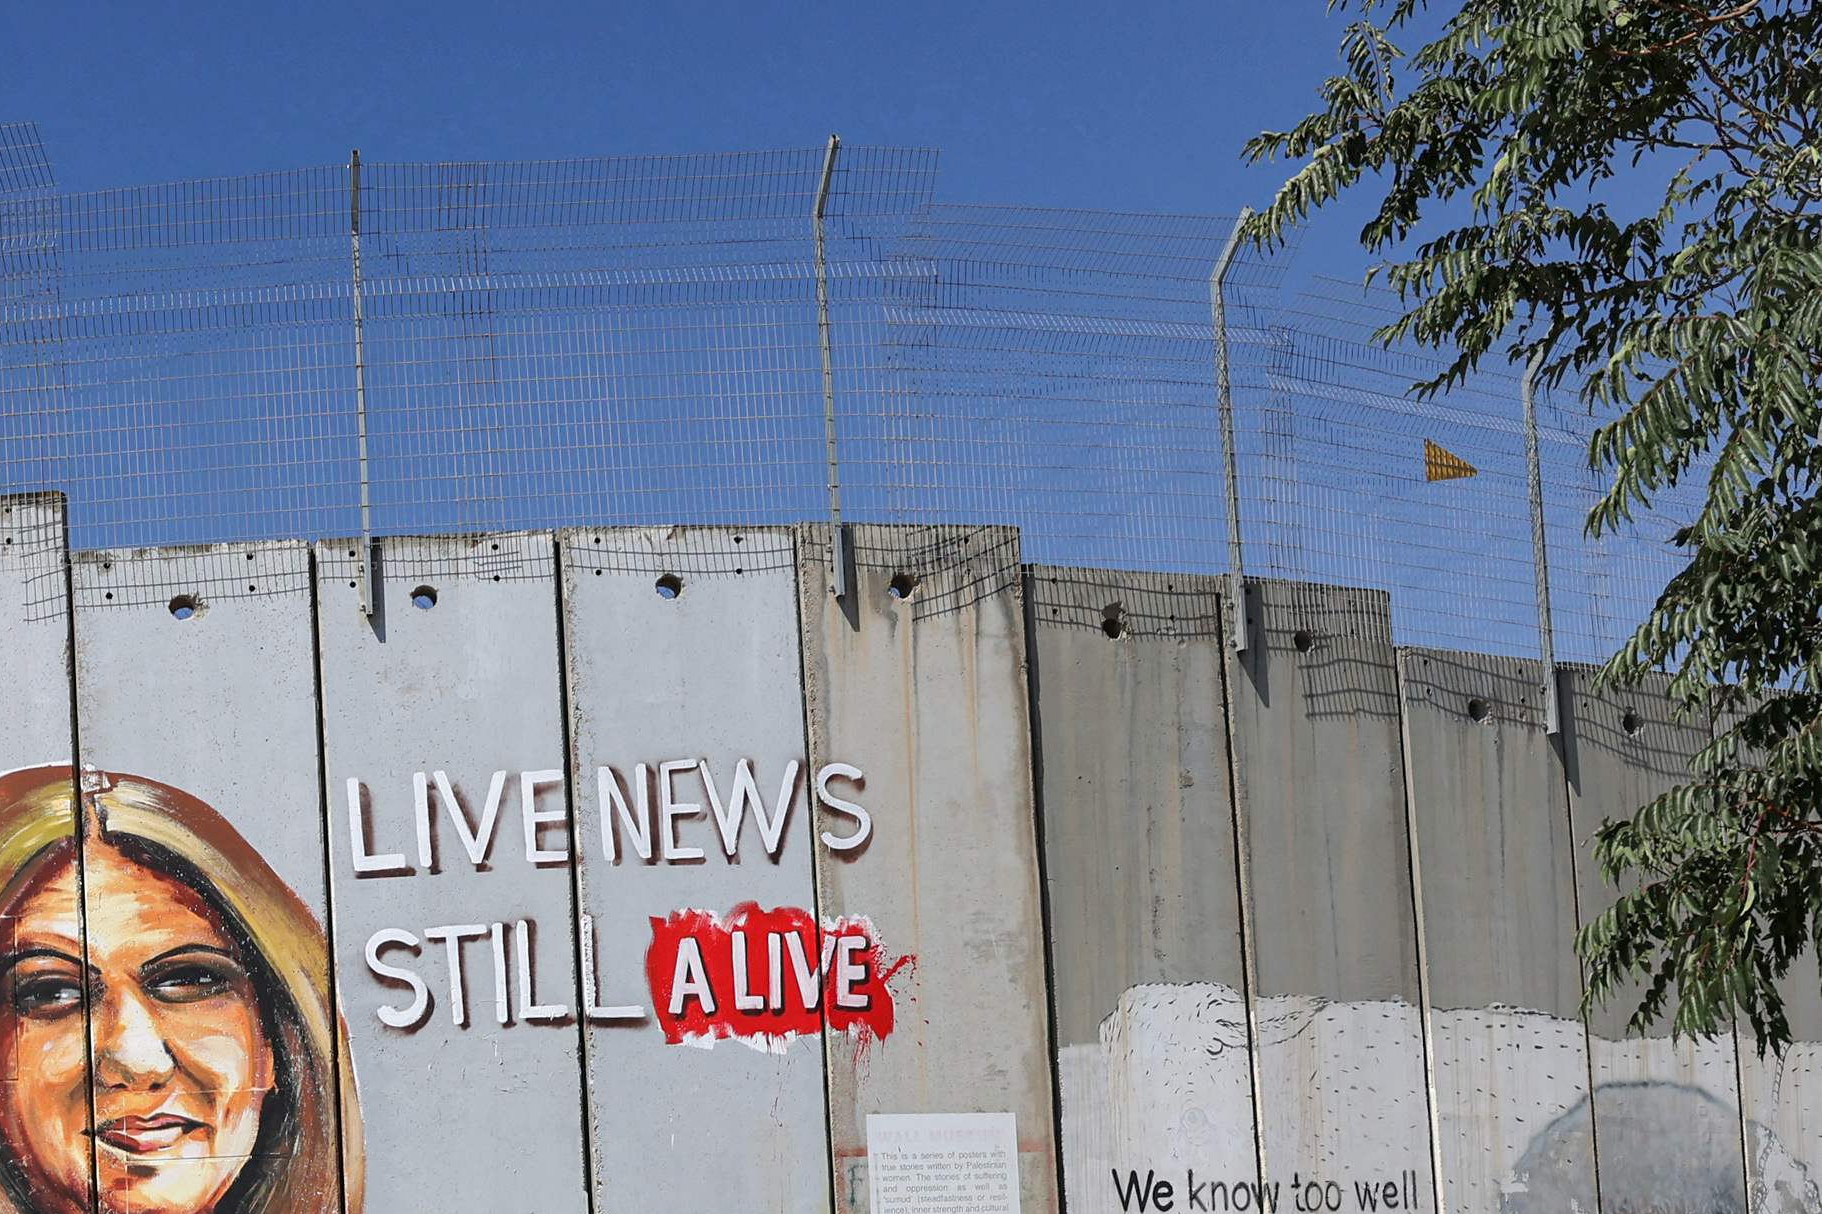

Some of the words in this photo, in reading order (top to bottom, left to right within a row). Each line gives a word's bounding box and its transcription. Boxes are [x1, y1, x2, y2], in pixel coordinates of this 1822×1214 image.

[346, 769, 569, 876] LIVE
[597, 757, 874, 863] NEWS
[364, 914, 652, 1030] STILL
[1112, 1169, 1175, 1213] We
[1187, 1169, 1280, 1213] know
[1290, 1171, 1342, 1212] too
[1354, 1170, 1418, 1211] well
